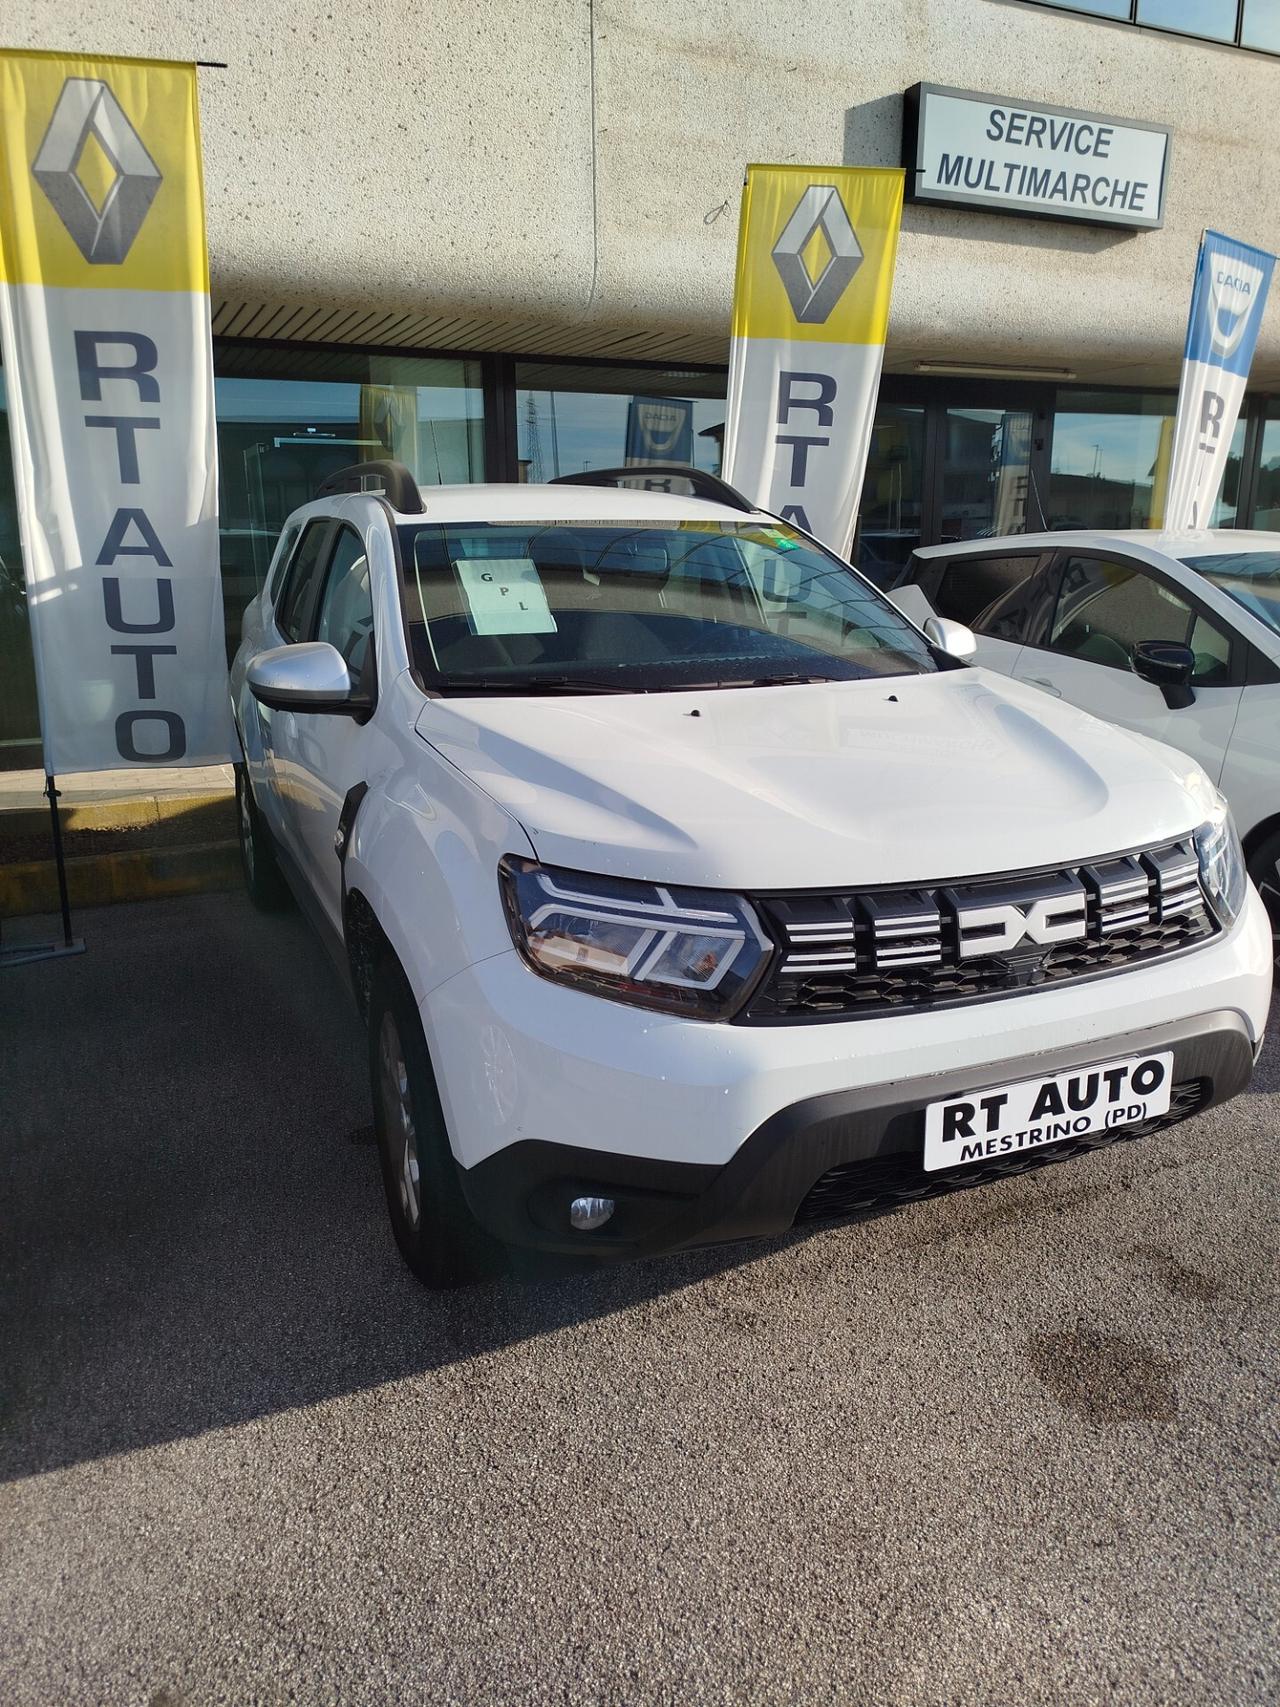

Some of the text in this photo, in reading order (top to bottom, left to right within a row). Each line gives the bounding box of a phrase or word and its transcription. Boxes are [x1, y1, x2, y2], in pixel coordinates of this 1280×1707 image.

[986, 109, 1114, 159] SERVICE
[936, 153, 1149, 212] MULTIMARCHE
[942, 1059, 1165, 1143] RT AUTO
[960, 1102, 1148, 1162] MESTRINO (PD)
